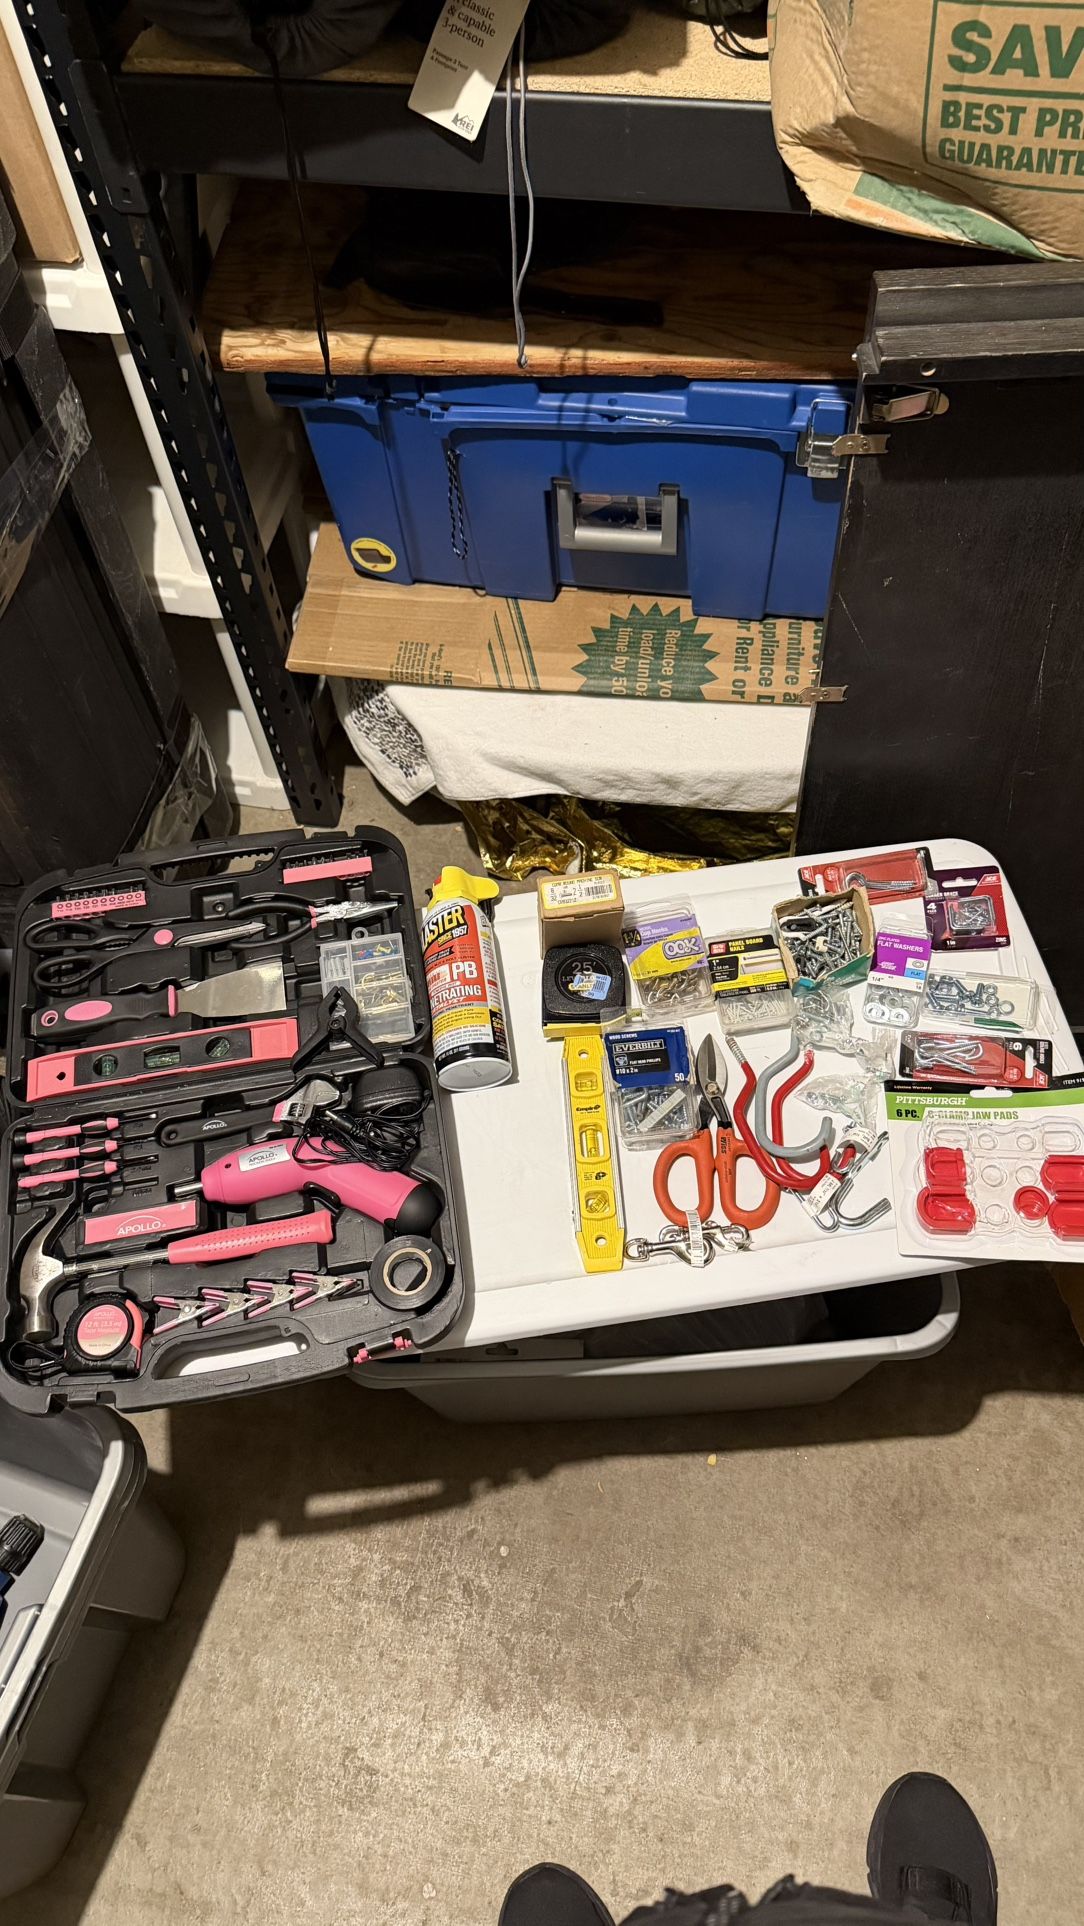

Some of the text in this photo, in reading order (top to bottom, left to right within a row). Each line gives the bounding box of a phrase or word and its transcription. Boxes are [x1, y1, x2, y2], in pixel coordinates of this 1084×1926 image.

[462, 0, 495, 20] classic
[447, 5, 496, 37] & capable
[442, 17, 485, 47] 3-person
[459, 120, 475, 131] REI
[940, 99, 1084, 141] BEST PR
[616, 627, 633, 653] time
[661, 629, 681, 676] Reduce
[733, 637, 755, 672] Rent
[758, 620, 780, 688] ppliance
[784, 621, 805, 686] urniture
[610, 656, 630, 673] by
[731, 678, 747, 700] or
[926, 902, 937, 910] 4
[452, 925, 468, 938] 1957
[664, 937, 700, 956] OOK
[893, 943, 924, 953] WASHERS
[452, 961, 478, 980] PB
[572, 961, 596, 975] 25'
[615, 1041, 662, 1052] EVERBILT
[1013, 1042, 1022, 1051] 6
[674, 1072, 685, 1081] 50
[895, 1095, 967, 1106] PITTSBURGH
[896, 1109, 920, 1119] 6 PC.
[972, 1111, 991, 1120] JAW
[993, 1111, 1019, 1120] PADS
[202, 1122, 226, 1131] APOLLO
[248, 1152, 275, 1163] APOLLO
[117, 1220, 162, 1236] APOLLO
